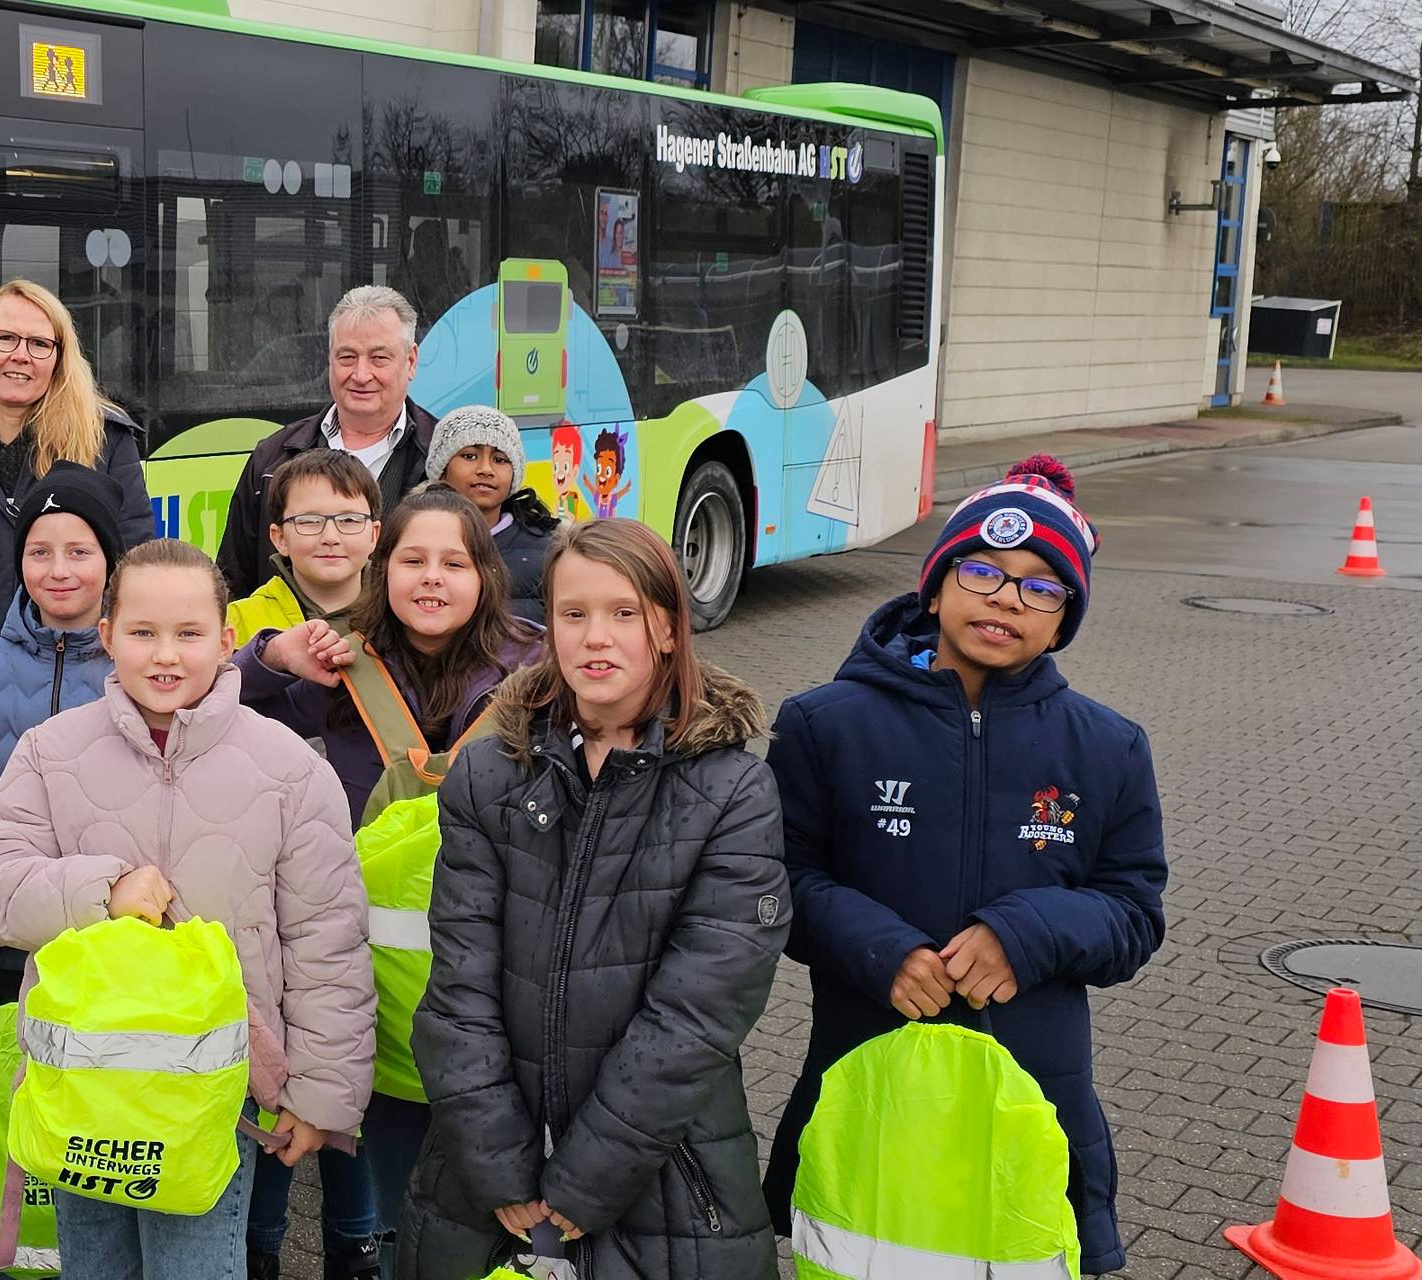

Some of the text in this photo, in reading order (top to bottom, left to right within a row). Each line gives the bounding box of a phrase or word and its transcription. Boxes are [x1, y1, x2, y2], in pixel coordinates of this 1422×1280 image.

[657, 125, 847, 180] Hagener Straßenbahn AG HST
[877, 817, 911, 837] #49
[68, 1136, 165, 1161] SICHER
[65, 1151, 161, 1175] UNTERWEGS
[58, 1168, 123, 1195] HST
